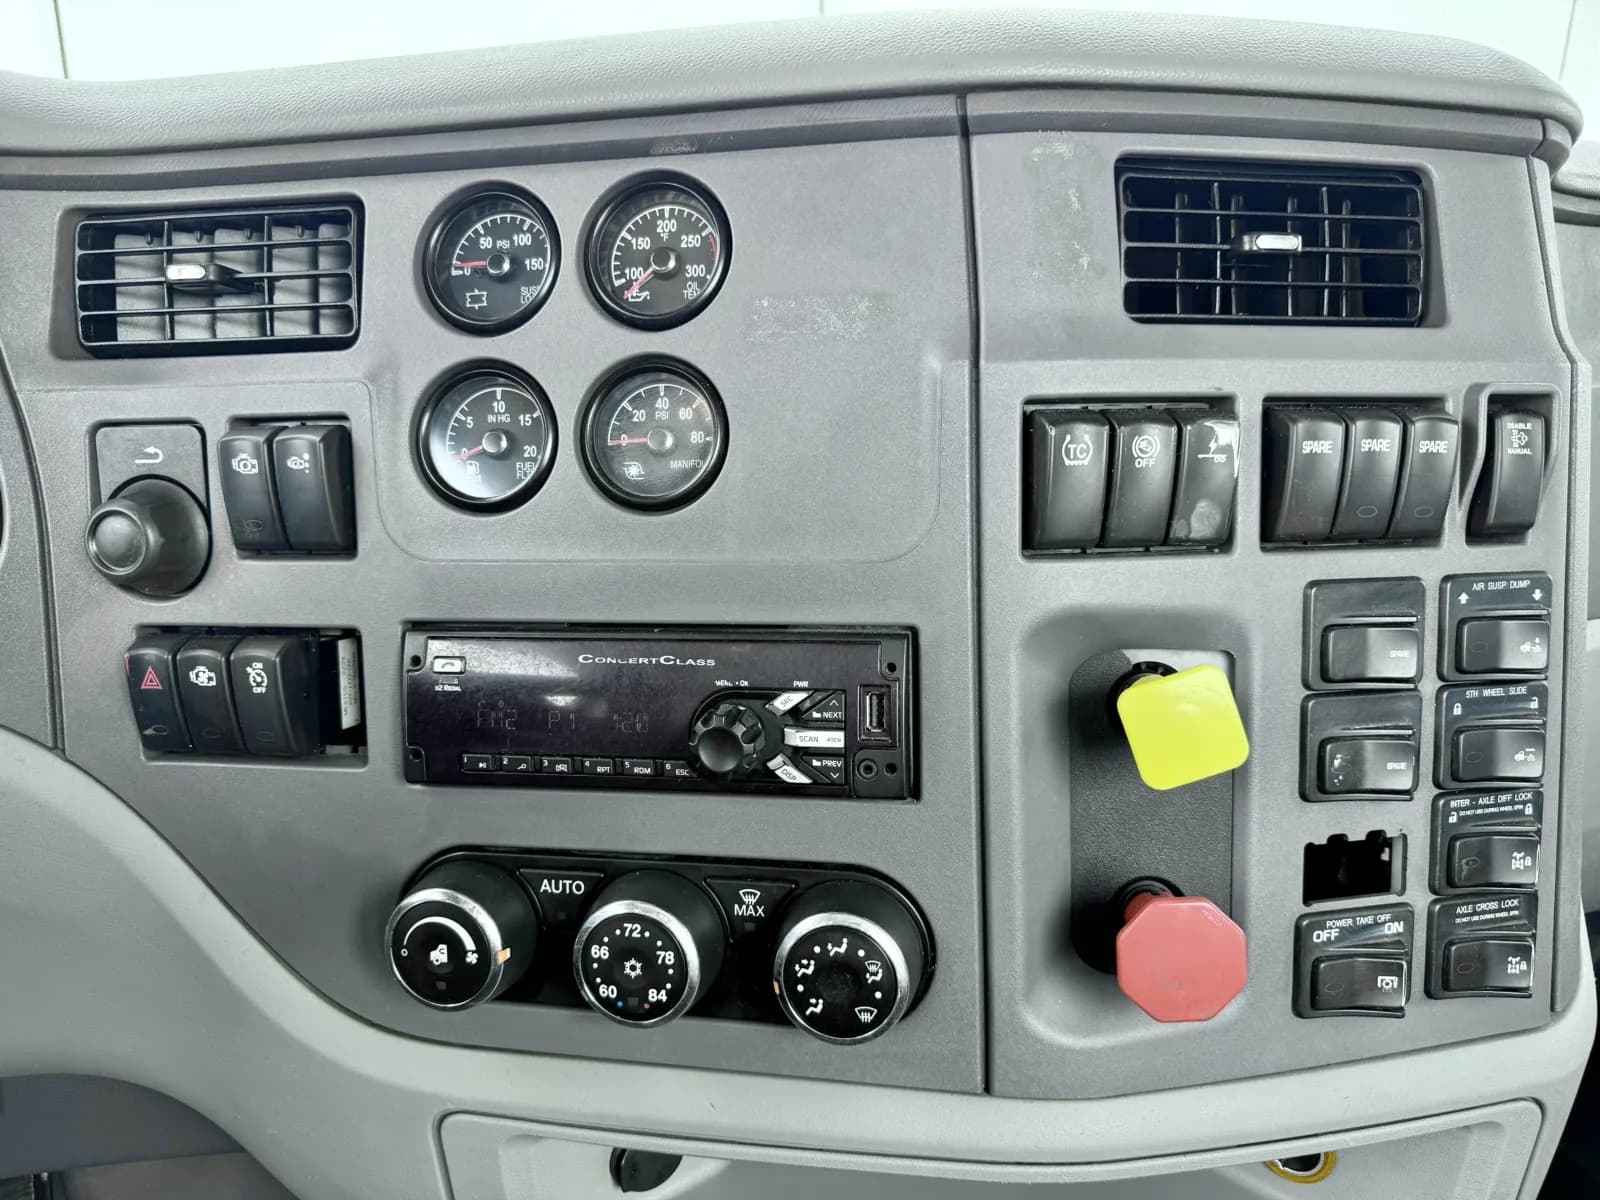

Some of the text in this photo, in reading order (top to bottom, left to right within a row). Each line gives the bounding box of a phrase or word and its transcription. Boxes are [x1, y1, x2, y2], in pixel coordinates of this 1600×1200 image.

[656, 219, 677, 233] 200
[479, 236, 493, 249] 50
[496, 240, 510, 249] PSI
[512, 233, 532, 246] 100
[631, 236, 651, 250] 150
[680, 234, 701, 248] 250
[524, 258, 544, 271] 150
[685, 264, 706, 278] 300
[624, 266, 644, 280] 100
[687, 281, 699, 291] OIL
[492, 400, 506, 413] 10
[655, 397, 669, 410] 40
[487, 414, 511, 423] IN HG
[632, 409, 646, 422] 20
[655, 411, 669, 420] PSI
[679, 407, 693, 419] 60
[466, 416, 474, 428] 5
[518, 414, 532, 426] 15
[620, 434, 628, 446] 0
[690, 431, 705, 443] 80
[523, 445, 537, 458] 20
[1067, 443, 1087, 459] TC
[1302, 440, 1333, 454] SPARE
[1360, 438, 1391, 452] SPARE
[1419, 440, 1448, 454] SPARE
[461, 447, 468, 460] 0
[1135, 458, 1157, 468] OFF
[1472, 579, 1531, 591] AIR SUSP DUMP
[793, 680, 809, 688] PWR
[1465, 686, 1528, 699] 5TH WHEEL SLIDE
[822, 711, 842, 719] NEXT
[799, 735, 819, 743] SCAN
[503, 757, 508, 765] 2
[543, 759, 549, 767] 3
[584, 760, 590, 768] 4
[624, 761, 630, 769] 5
[822, 759, 842, 768] PREV
[596, 766, 611, 774] RPT
[633, 766, 651, 775] RDM
[675, 768, 690, 776] ESC
[1450, 798, 1470, 809] INTER
[1478, 795, 1496, 805] AXLE
[1498, 793, 1513, 803] DIFF
[1514, 791, 1533, 801] LOCK
[540, 879, 585, 895] AUTO
[734, 903, 765, 918] MAX
[1455, 898, 1519, 914] AXLE CROSS LOCK
[1326, 914, 1392, 929] POWER TAKE OFF
[1384, 921, 1404, 935] ON
[623, 923, 642, 938] 72
[1312, 929, 1340, 943] OFF
[591, 944, 609, 960] 66
[656, 951, 675, 965] 78
[599, 984, 618, 999] 60
[648, 988, 667, 1003] 84
